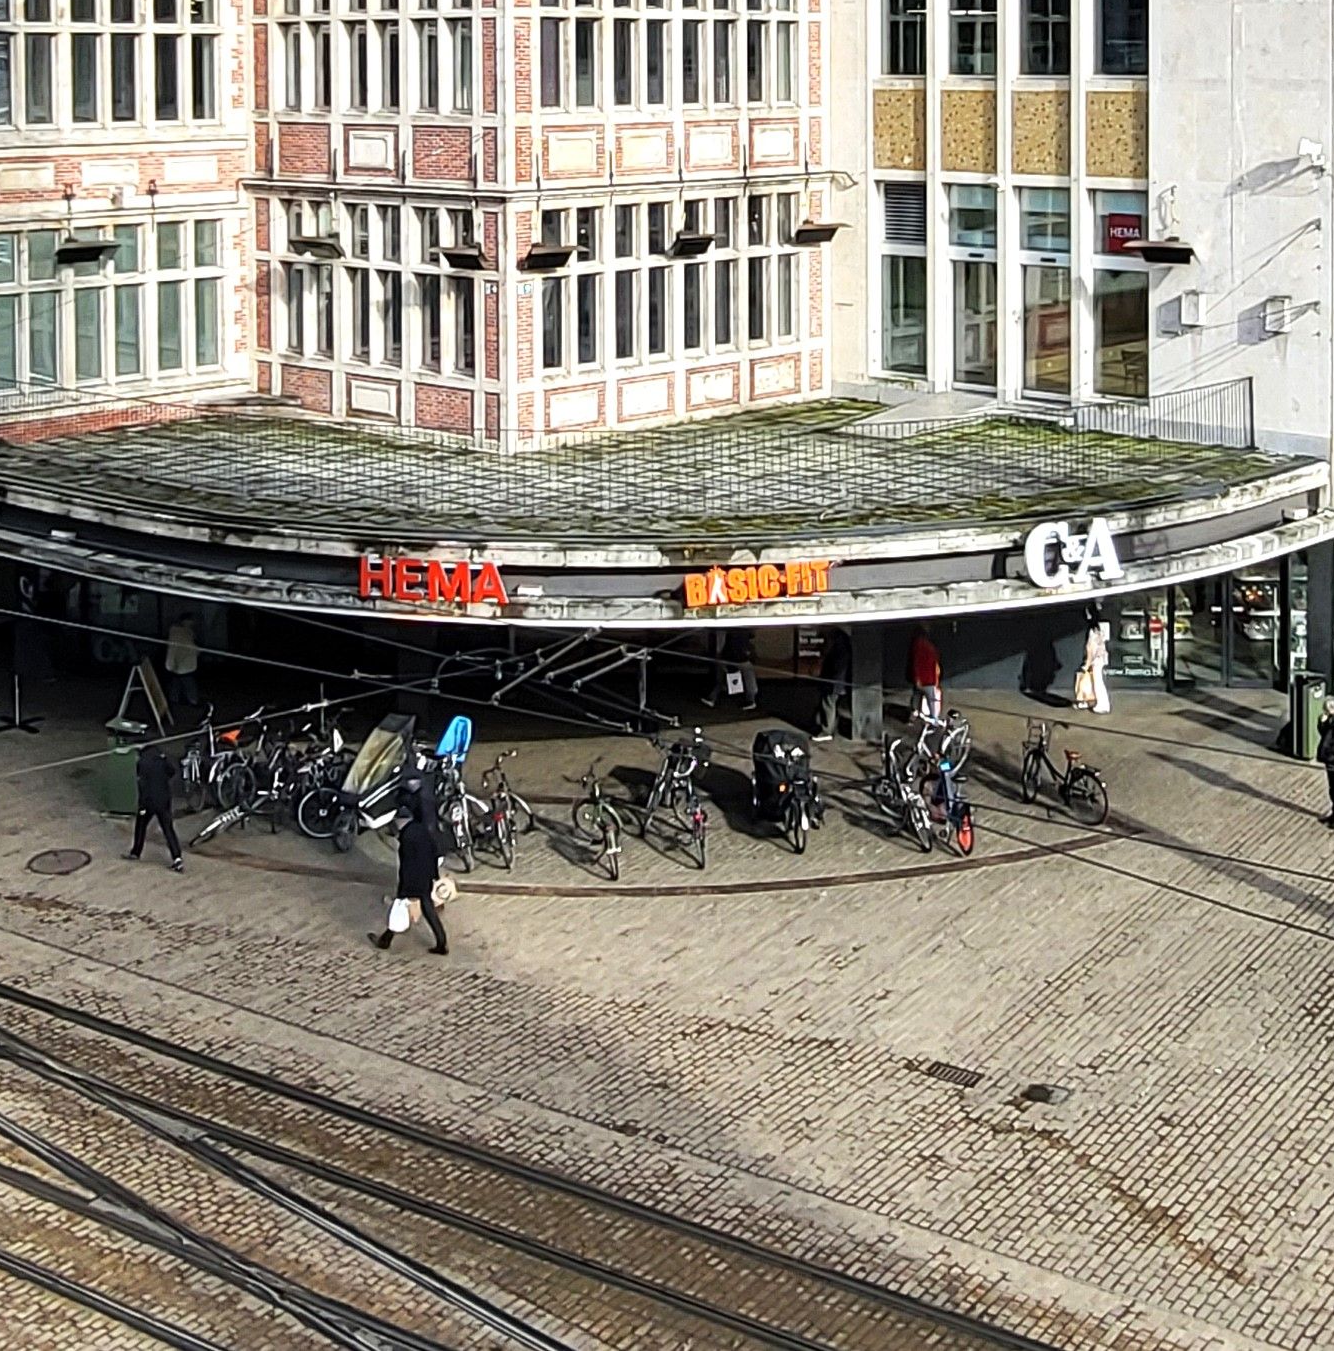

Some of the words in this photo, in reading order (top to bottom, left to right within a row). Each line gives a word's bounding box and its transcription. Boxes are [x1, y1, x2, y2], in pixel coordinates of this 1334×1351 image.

[1109, 227, 1141, 238] HEMA
[1025, 517, 1125, 588] C&A
[359, 554, 510, 605] HEMA
